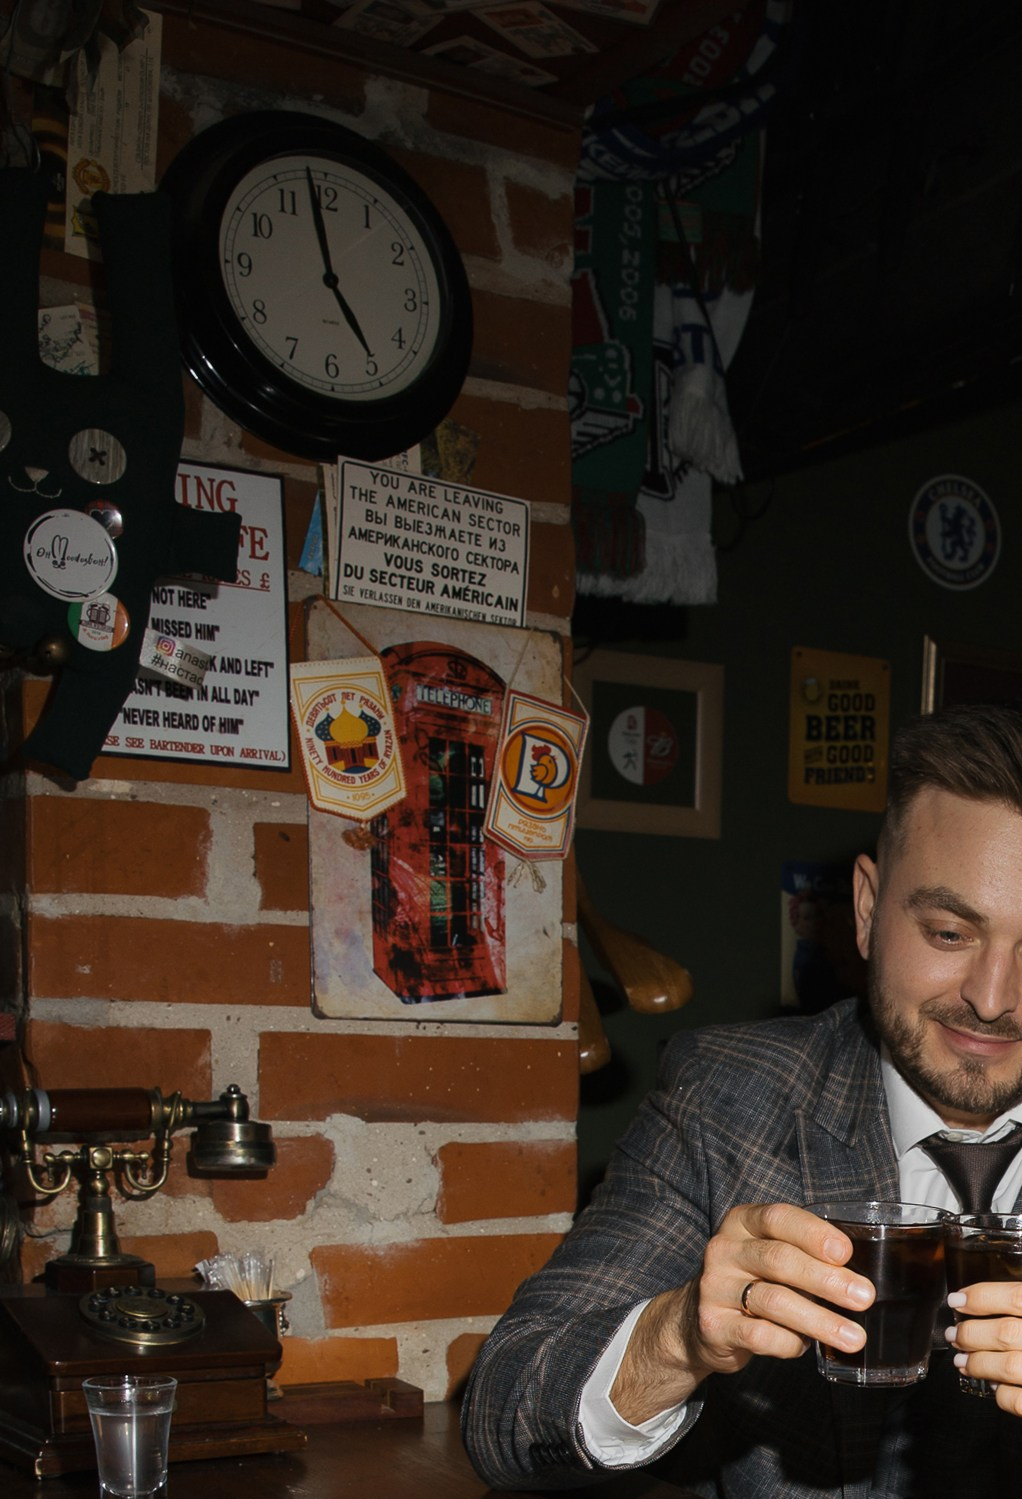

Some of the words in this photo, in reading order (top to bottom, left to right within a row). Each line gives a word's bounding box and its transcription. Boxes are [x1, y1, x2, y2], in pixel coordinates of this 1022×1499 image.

[278, 188, 299, 216] 11
[315, 185, 339, 212] 12
[251, 212, 274, 240] 10
[363, 204, 372, 229] 1
[237, 252, 253, 277] 9
[391, 242, 405, 266] 2
[252, 299, 267, 325] 8
[403, 288, 418, 313] 3
[284, 336, 299, 360] 7
[390, 327, 406, 350] 4
[324, 353, 340, 379] 6
[364, 350, 379, 377] 5
[370, 471, 400, 490] YOU
[407, 481, 437, 499] ARE
[444, 488, 504, 515] LEAVING
[350, 486, 378, 504] THE
[386, 496, 461, 523] AMERICAN
[468, 513, 521, 538] SECTOR
[365, 508, 388, 526] ВЫ
[394, 515, 482, 548] ВЫЕЗЖАЕТЕ
[489, 536, 507, 553] ИЗ
[348, 525, 460, 562] АМЕРИКАНСКОГО
[466, 551, 520, 576] СЕКТОРА
[259, 572, 270, 589] £
[384, 552, 424, 574] VOUS
[431, 563, 487, 588] SORTEZ
[152, 587, 175, 606] NOT
[344, 563, 364, 580] DU
[369, 569, 435, 596] SECTEUR
[440, 585, 519, 613] AMÉRICAIN
[342, 584, 355, 597] SIE
[359, 588, 404, 605] VERLASSEN
[407, 597, 421, 609] DEN
[425, 601, 487, 619] AMERIKANISCHEN
[151, 617, 193, 639] MISSED
[220, 657, 242, 675] AND
[211, 686, 232, 704] ALL
[417, 685, 491, 714] TELEPHONE
[828, 693, 876, 713] GOOD
[163, 711, 200, 732] HEARD
[202, 715, 217, 732] OF
[805, 715, 876, 742] BEER
[125, 738, 145, 749] SEE
[150, 740, 206, 755] BARTENDER
[210, 745, 236, 758] UPON
[826, 744, 874, 764] GOOD
